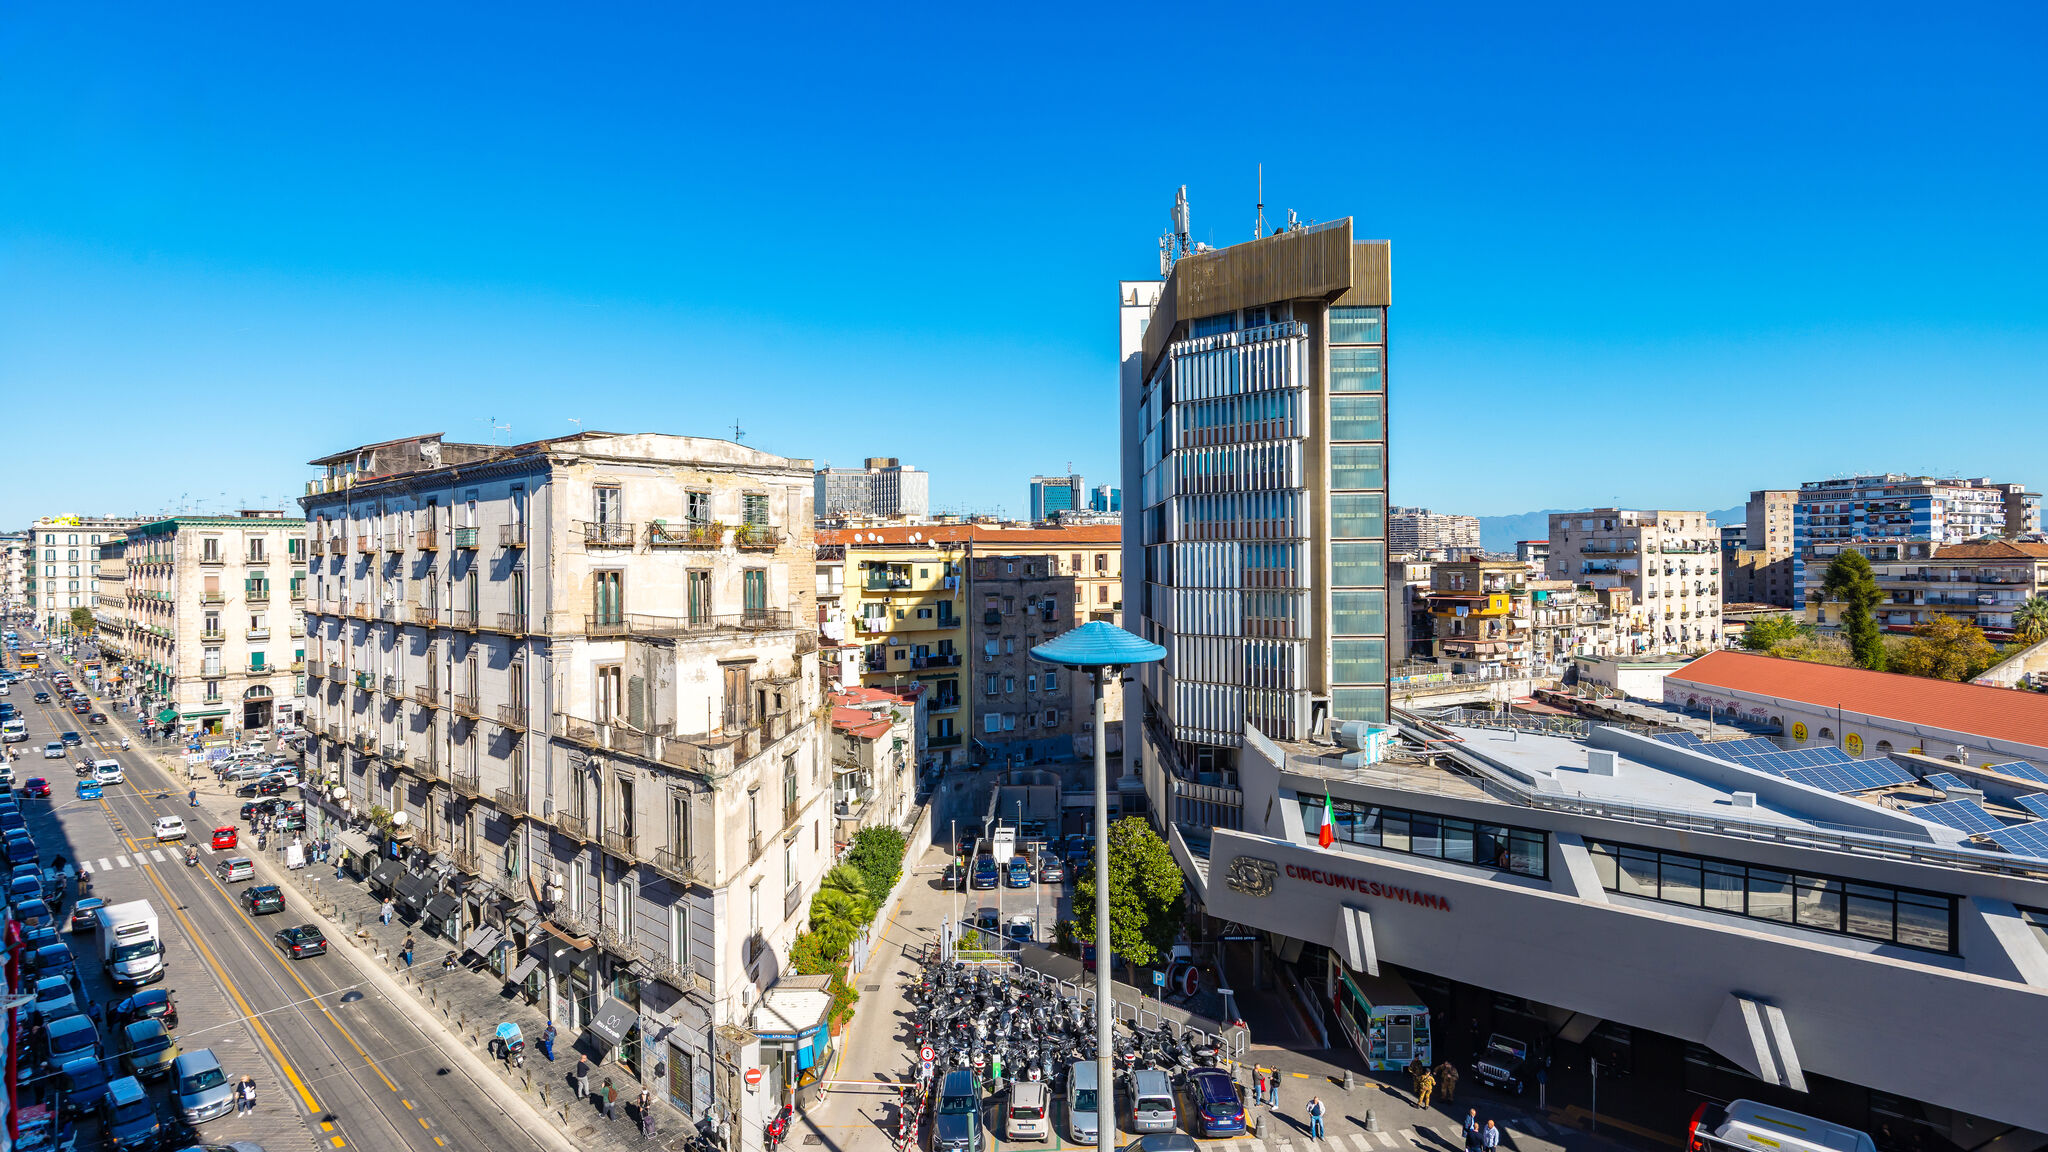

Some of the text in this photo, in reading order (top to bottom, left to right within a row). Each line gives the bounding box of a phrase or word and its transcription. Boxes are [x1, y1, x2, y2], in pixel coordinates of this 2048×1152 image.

[54, 516, 81, 526] HOTEL
[1285, 864, 1451, 912] CIRCUMVESUVIANA
[1155, 973, 1163, 984] P
[925, 1050, 930, 1058] 5
